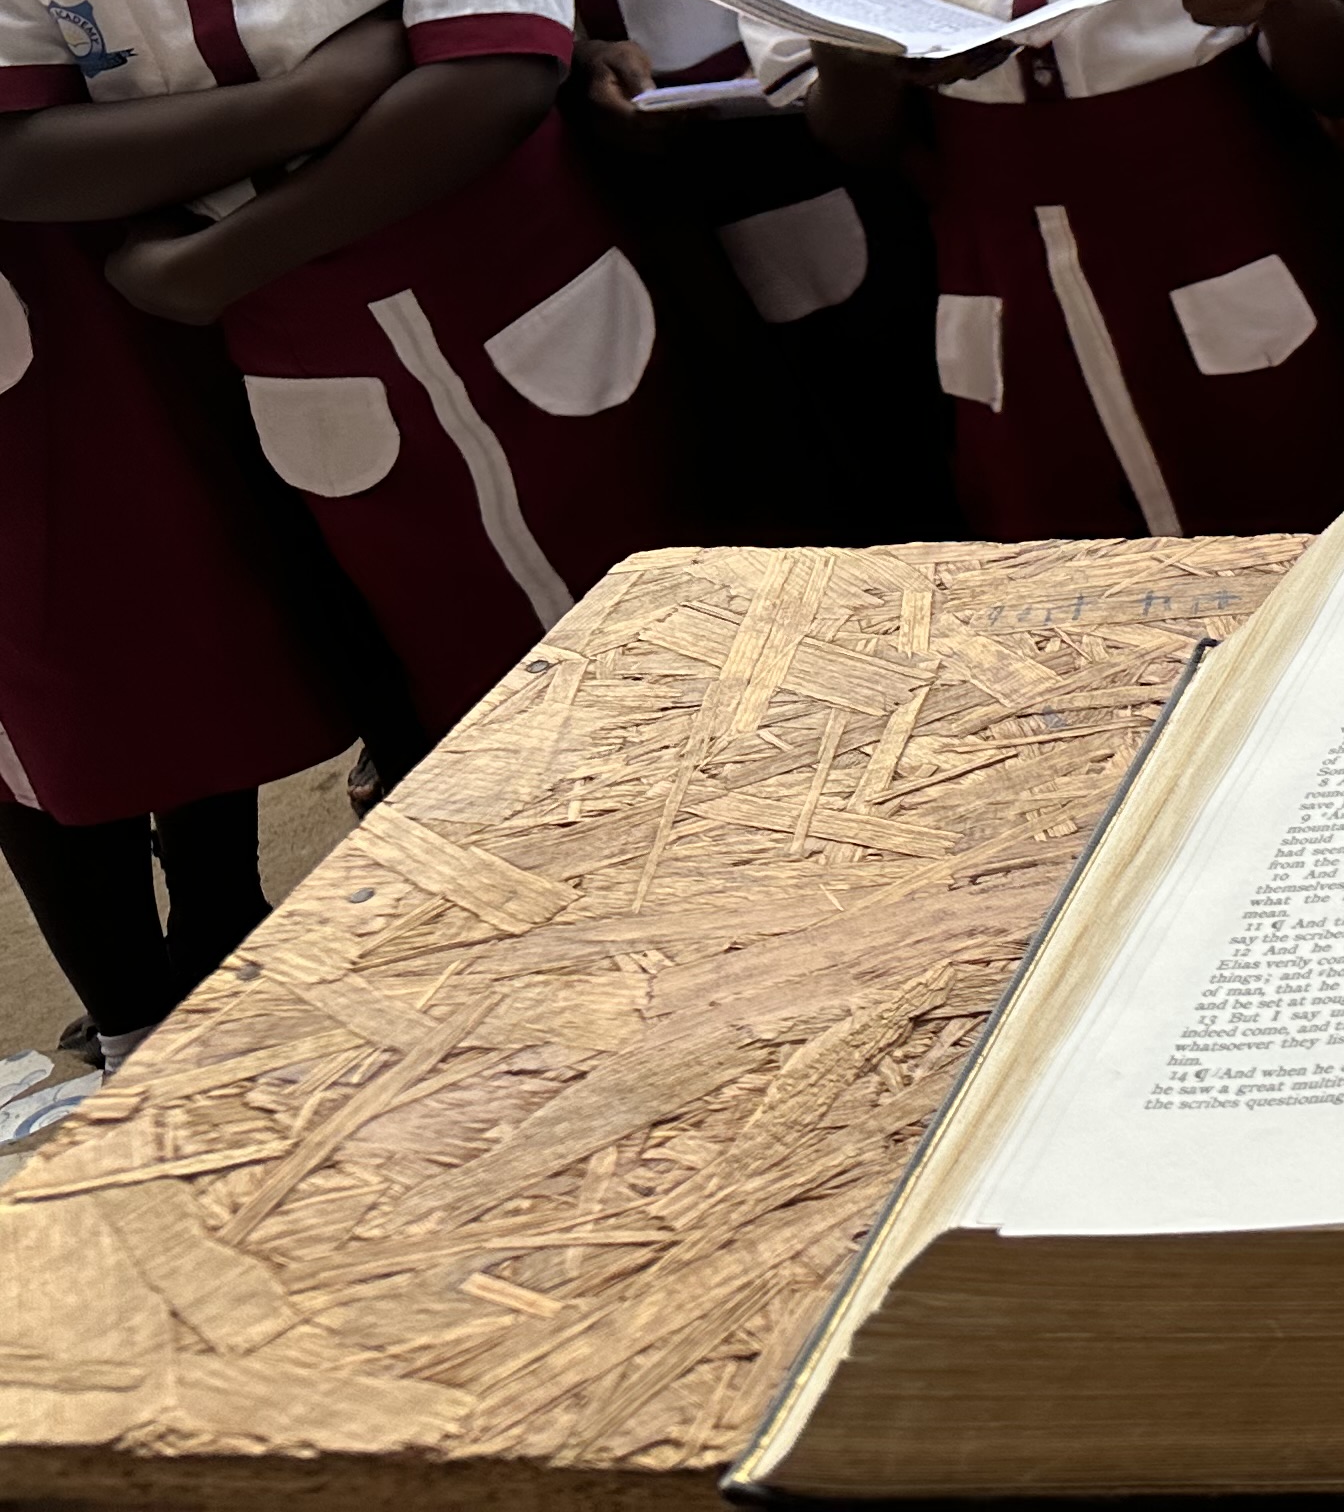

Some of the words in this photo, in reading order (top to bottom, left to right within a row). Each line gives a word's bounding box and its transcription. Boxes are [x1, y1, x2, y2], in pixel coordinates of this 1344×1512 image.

[1268, 860, 1305, 870] from
[1313, 857, 1340, 867] the
[1242, 910, 1290, 919] mean.
[1194, 999, 1229, 1011] and
[1232, 999, 1253, 1009] be
[1256, 998, 1284, 1009] set
[1287, 997, 1307, 1007] at
[1175, 1041, 1275, 1052] whatsoever
[1281, 1037, 1321, 1050] they
[1166, 1055, 1202, 1066] him.
[1144, 1098, 1174, 1110] the
[1178, 1097, 1240, 1109] scribes
